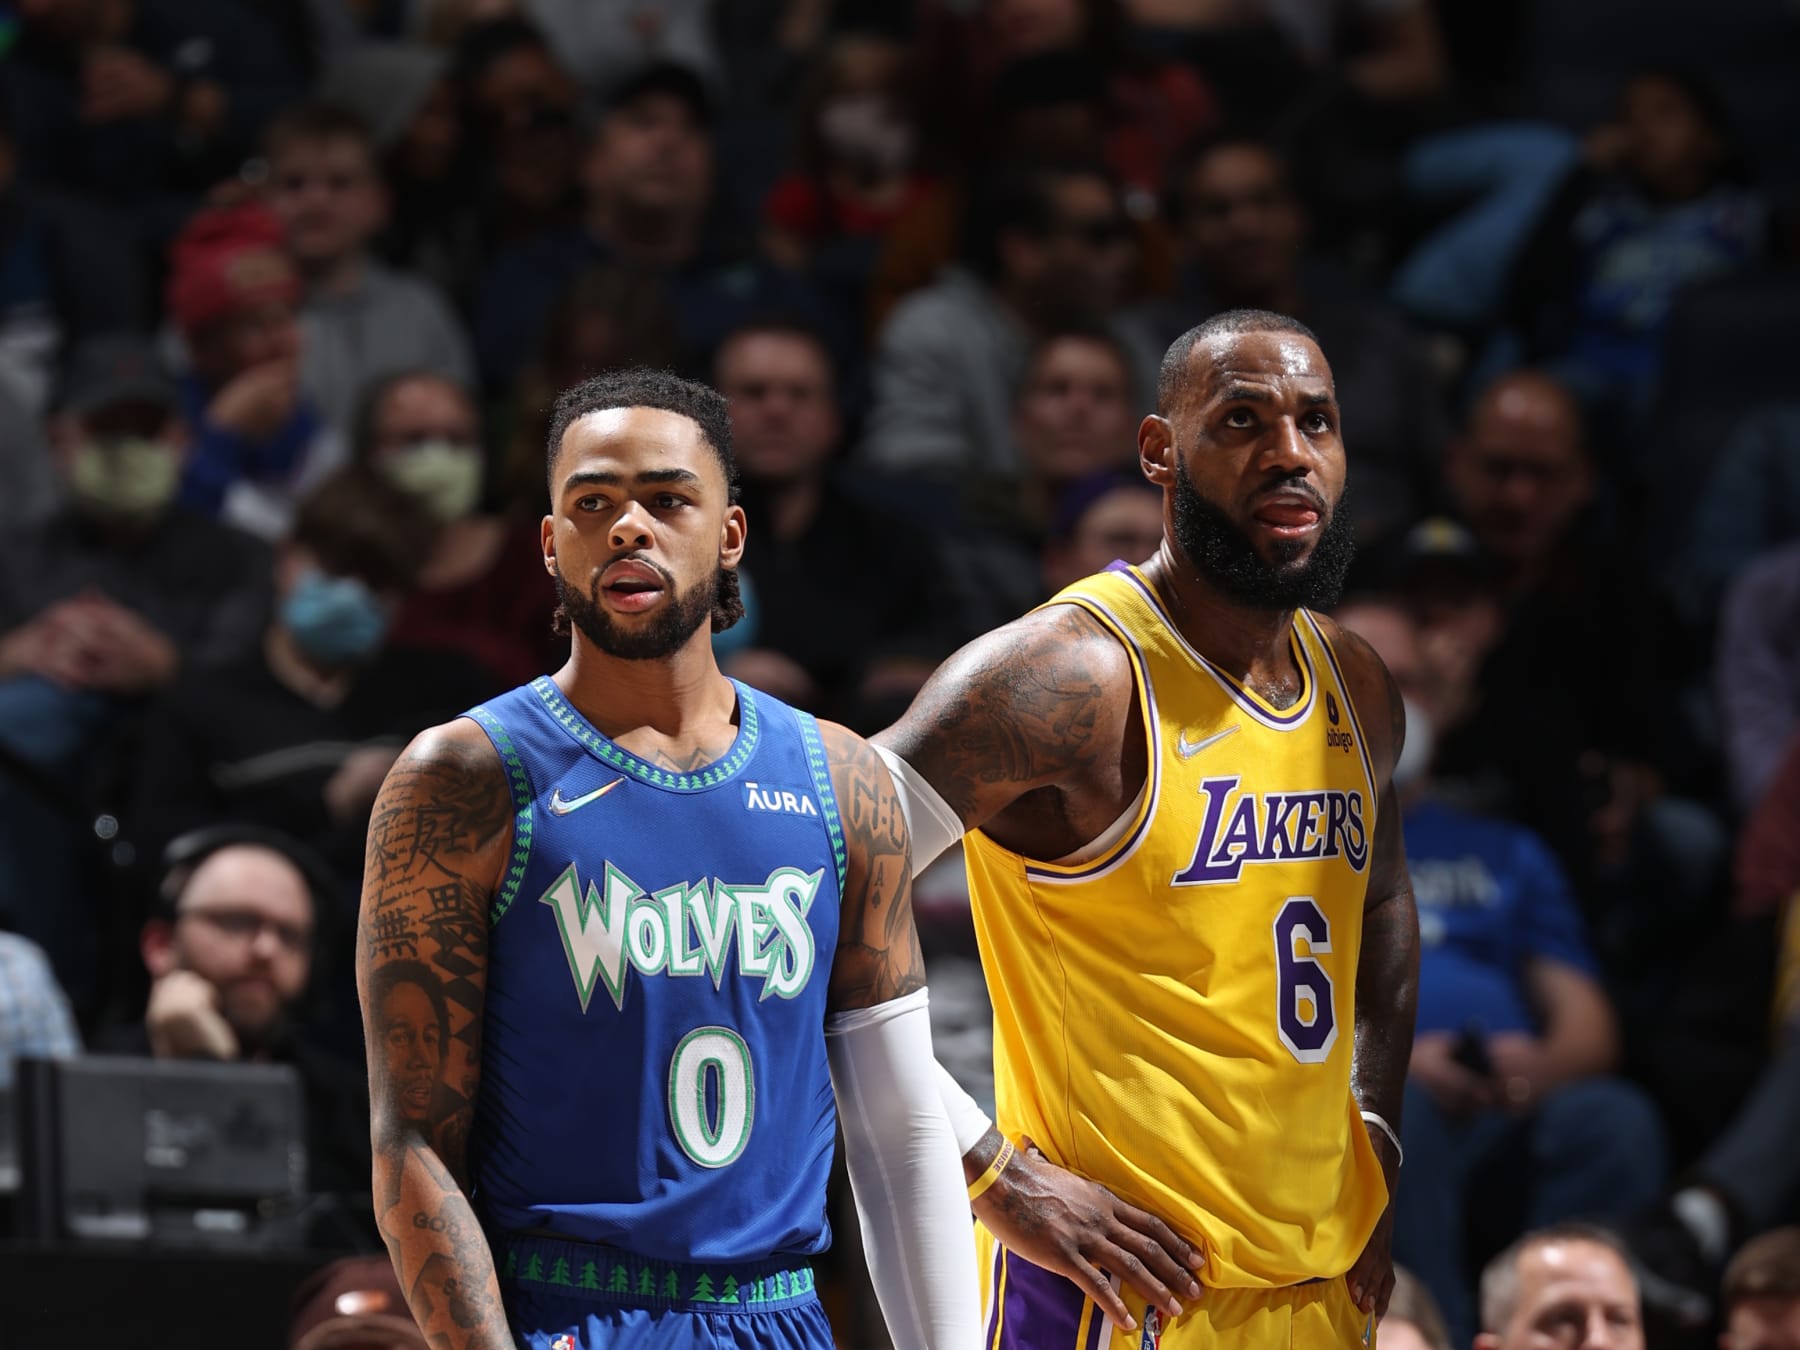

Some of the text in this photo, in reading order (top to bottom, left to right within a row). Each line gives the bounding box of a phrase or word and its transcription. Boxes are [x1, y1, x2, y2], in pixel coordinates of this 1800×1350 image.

[1327, 728, 1353, 753] bibigo
[1170, 775, 1368, 887] LAKERS
[538, 859, 825, 1015] WOLVES
[1273, 896, 1339, 1064] 6
[668, 1026, 755, 1168] 0
